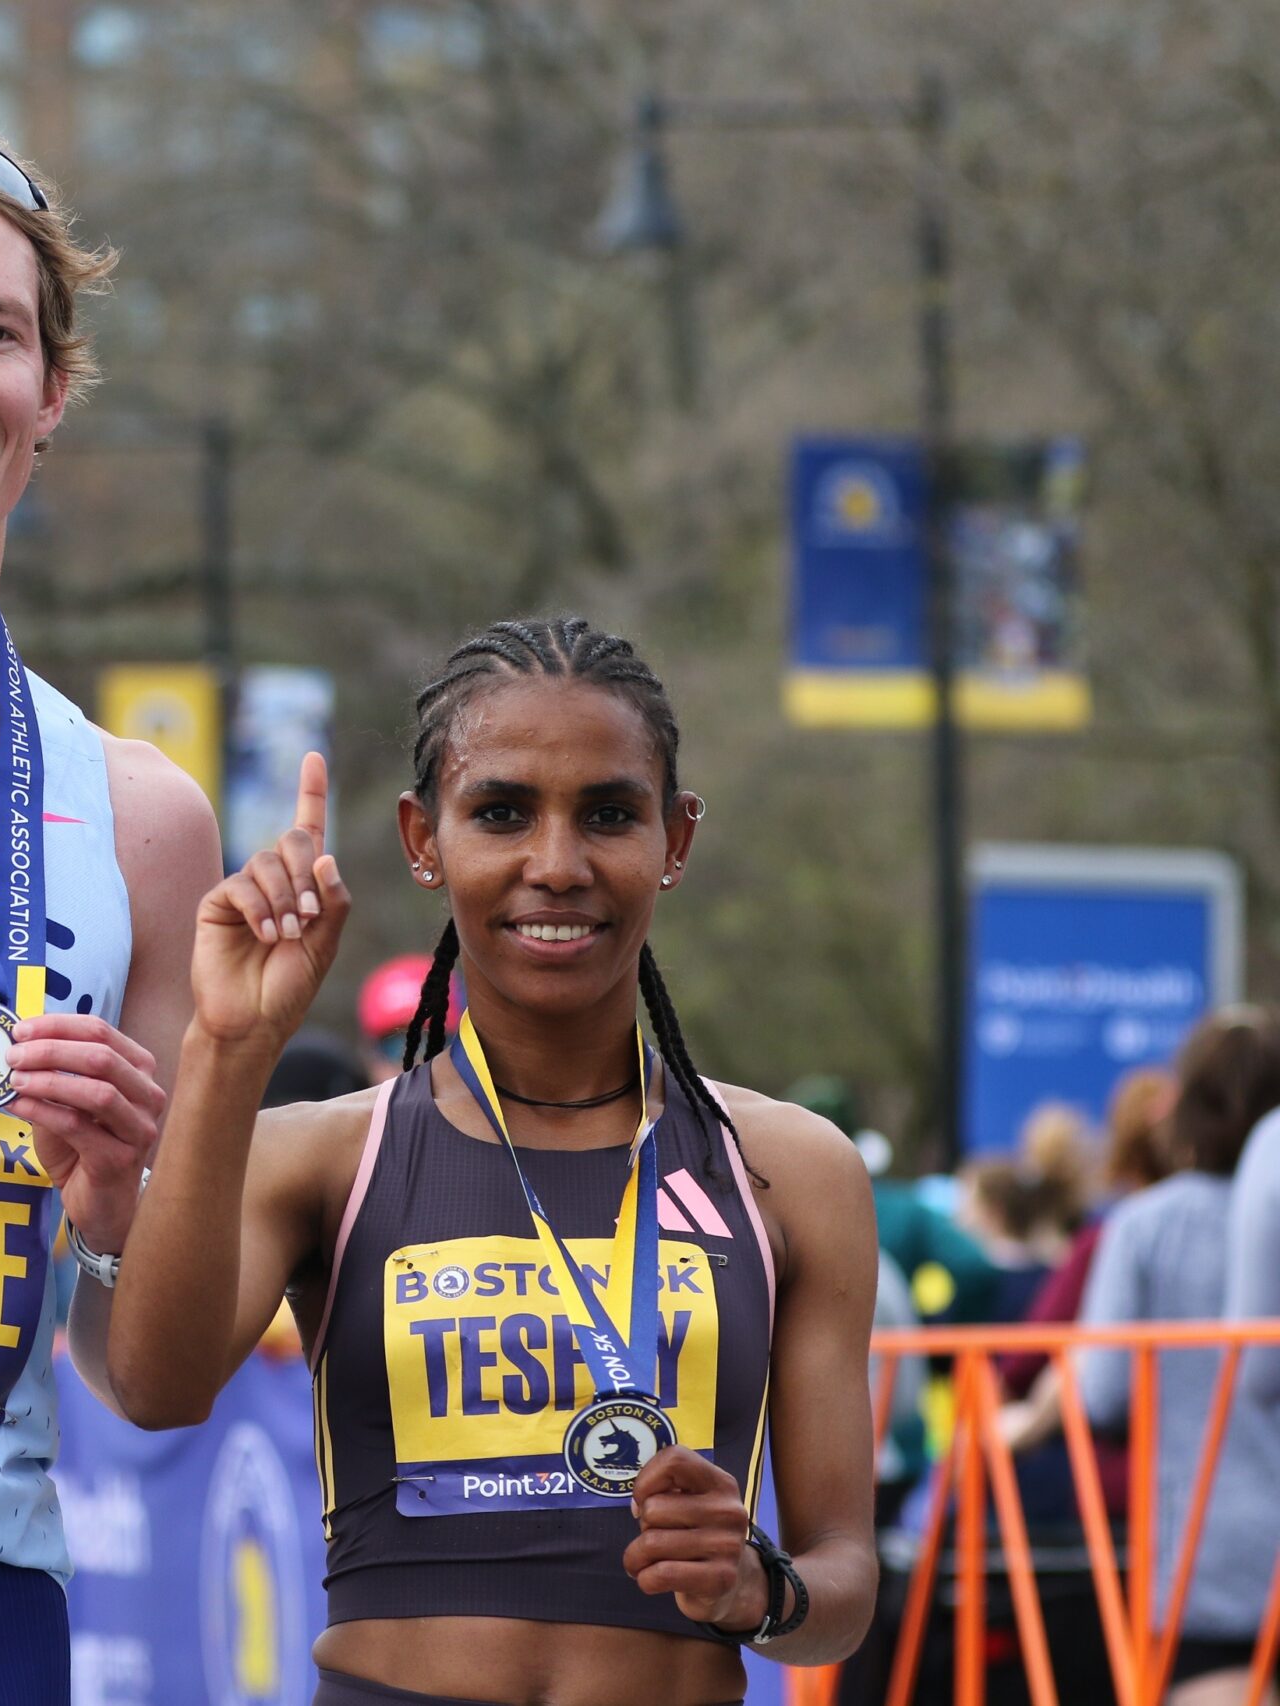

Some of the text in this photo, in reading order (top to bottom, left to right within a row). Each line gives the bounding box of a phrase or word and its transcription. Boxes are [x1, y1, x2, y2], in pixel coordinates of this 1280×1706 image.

[0, 611, 31, 962] OSTON ATHLETIC ASSOCIATION
[589, 1330, 617, 1354] 5K
[410, 1310, 693, 1419] TESFY
[586, 1405, 662, 1430] BOSTON 5K
[580, 1468, 613, 1491] B.A.A.
